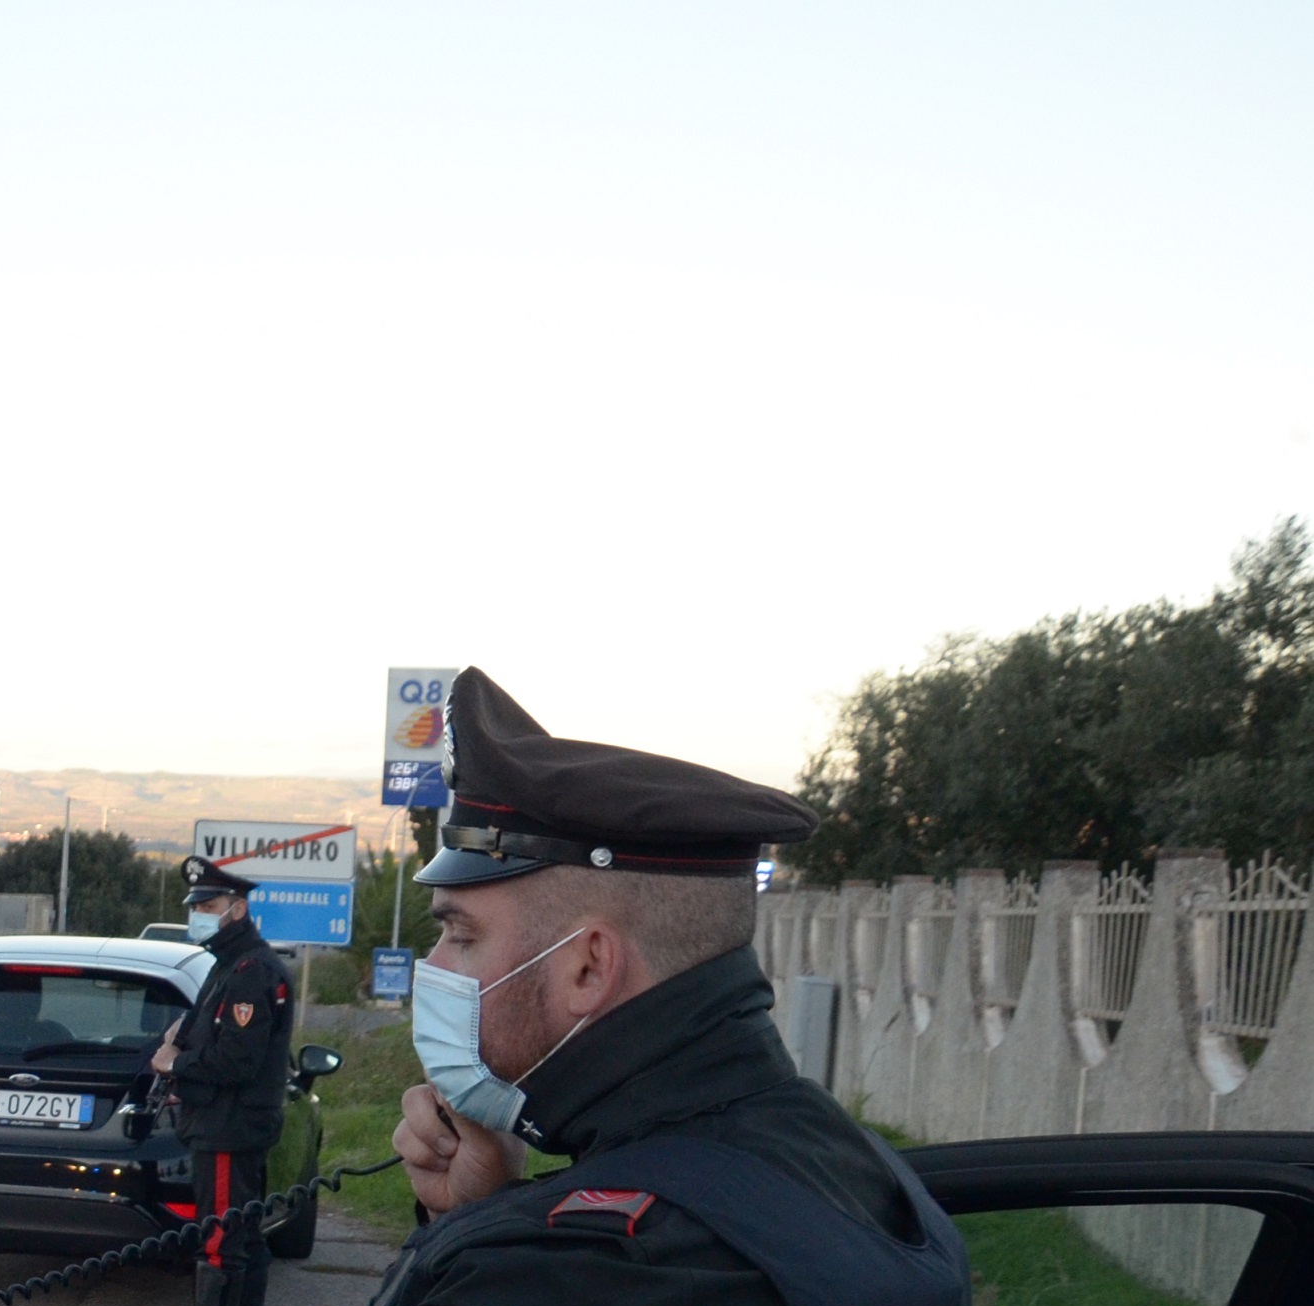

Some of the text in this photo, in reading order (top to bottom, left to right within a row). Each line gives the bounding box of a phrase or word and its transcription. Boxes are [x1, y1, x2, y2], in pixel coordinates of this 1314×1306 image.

[400, 680, 442, 704] Q8
[204, 835, 339, 862] VILLACIDRO
[269, 891, 330, 905] MONREALE
[329, 918, 346, 934] 18
